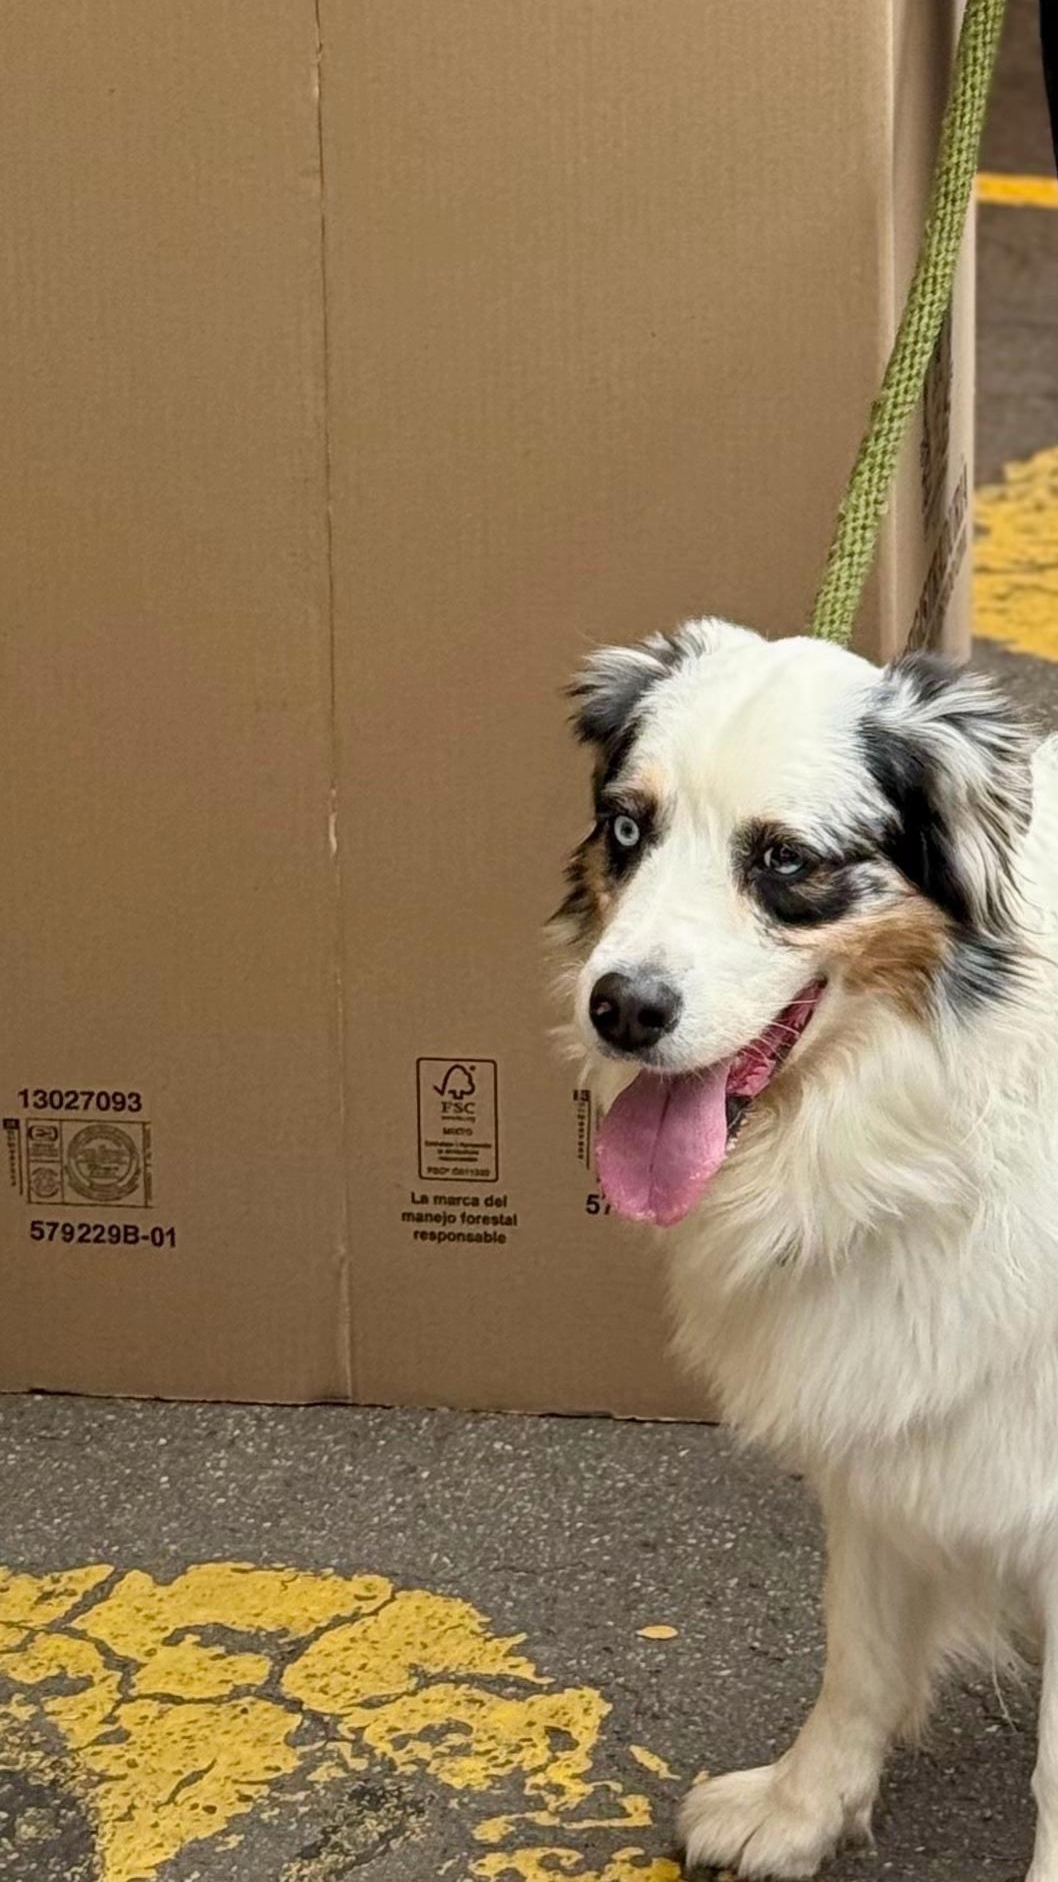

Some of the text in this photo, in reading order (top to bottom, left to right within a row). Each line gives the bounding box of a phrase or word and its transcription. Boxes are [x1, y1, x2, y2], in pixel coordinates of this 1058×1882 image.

[18, 1089, 143, 1112] 13027093
[441, 1101, 476, 1114] FSC
[411, 1191, 507, 1208] La marca del
[401, 1211, 517, 1227] manejo forestal
[30, 1220, 176, 1248] 579229B-01
[413, 1229, 507, 1244] responsable
